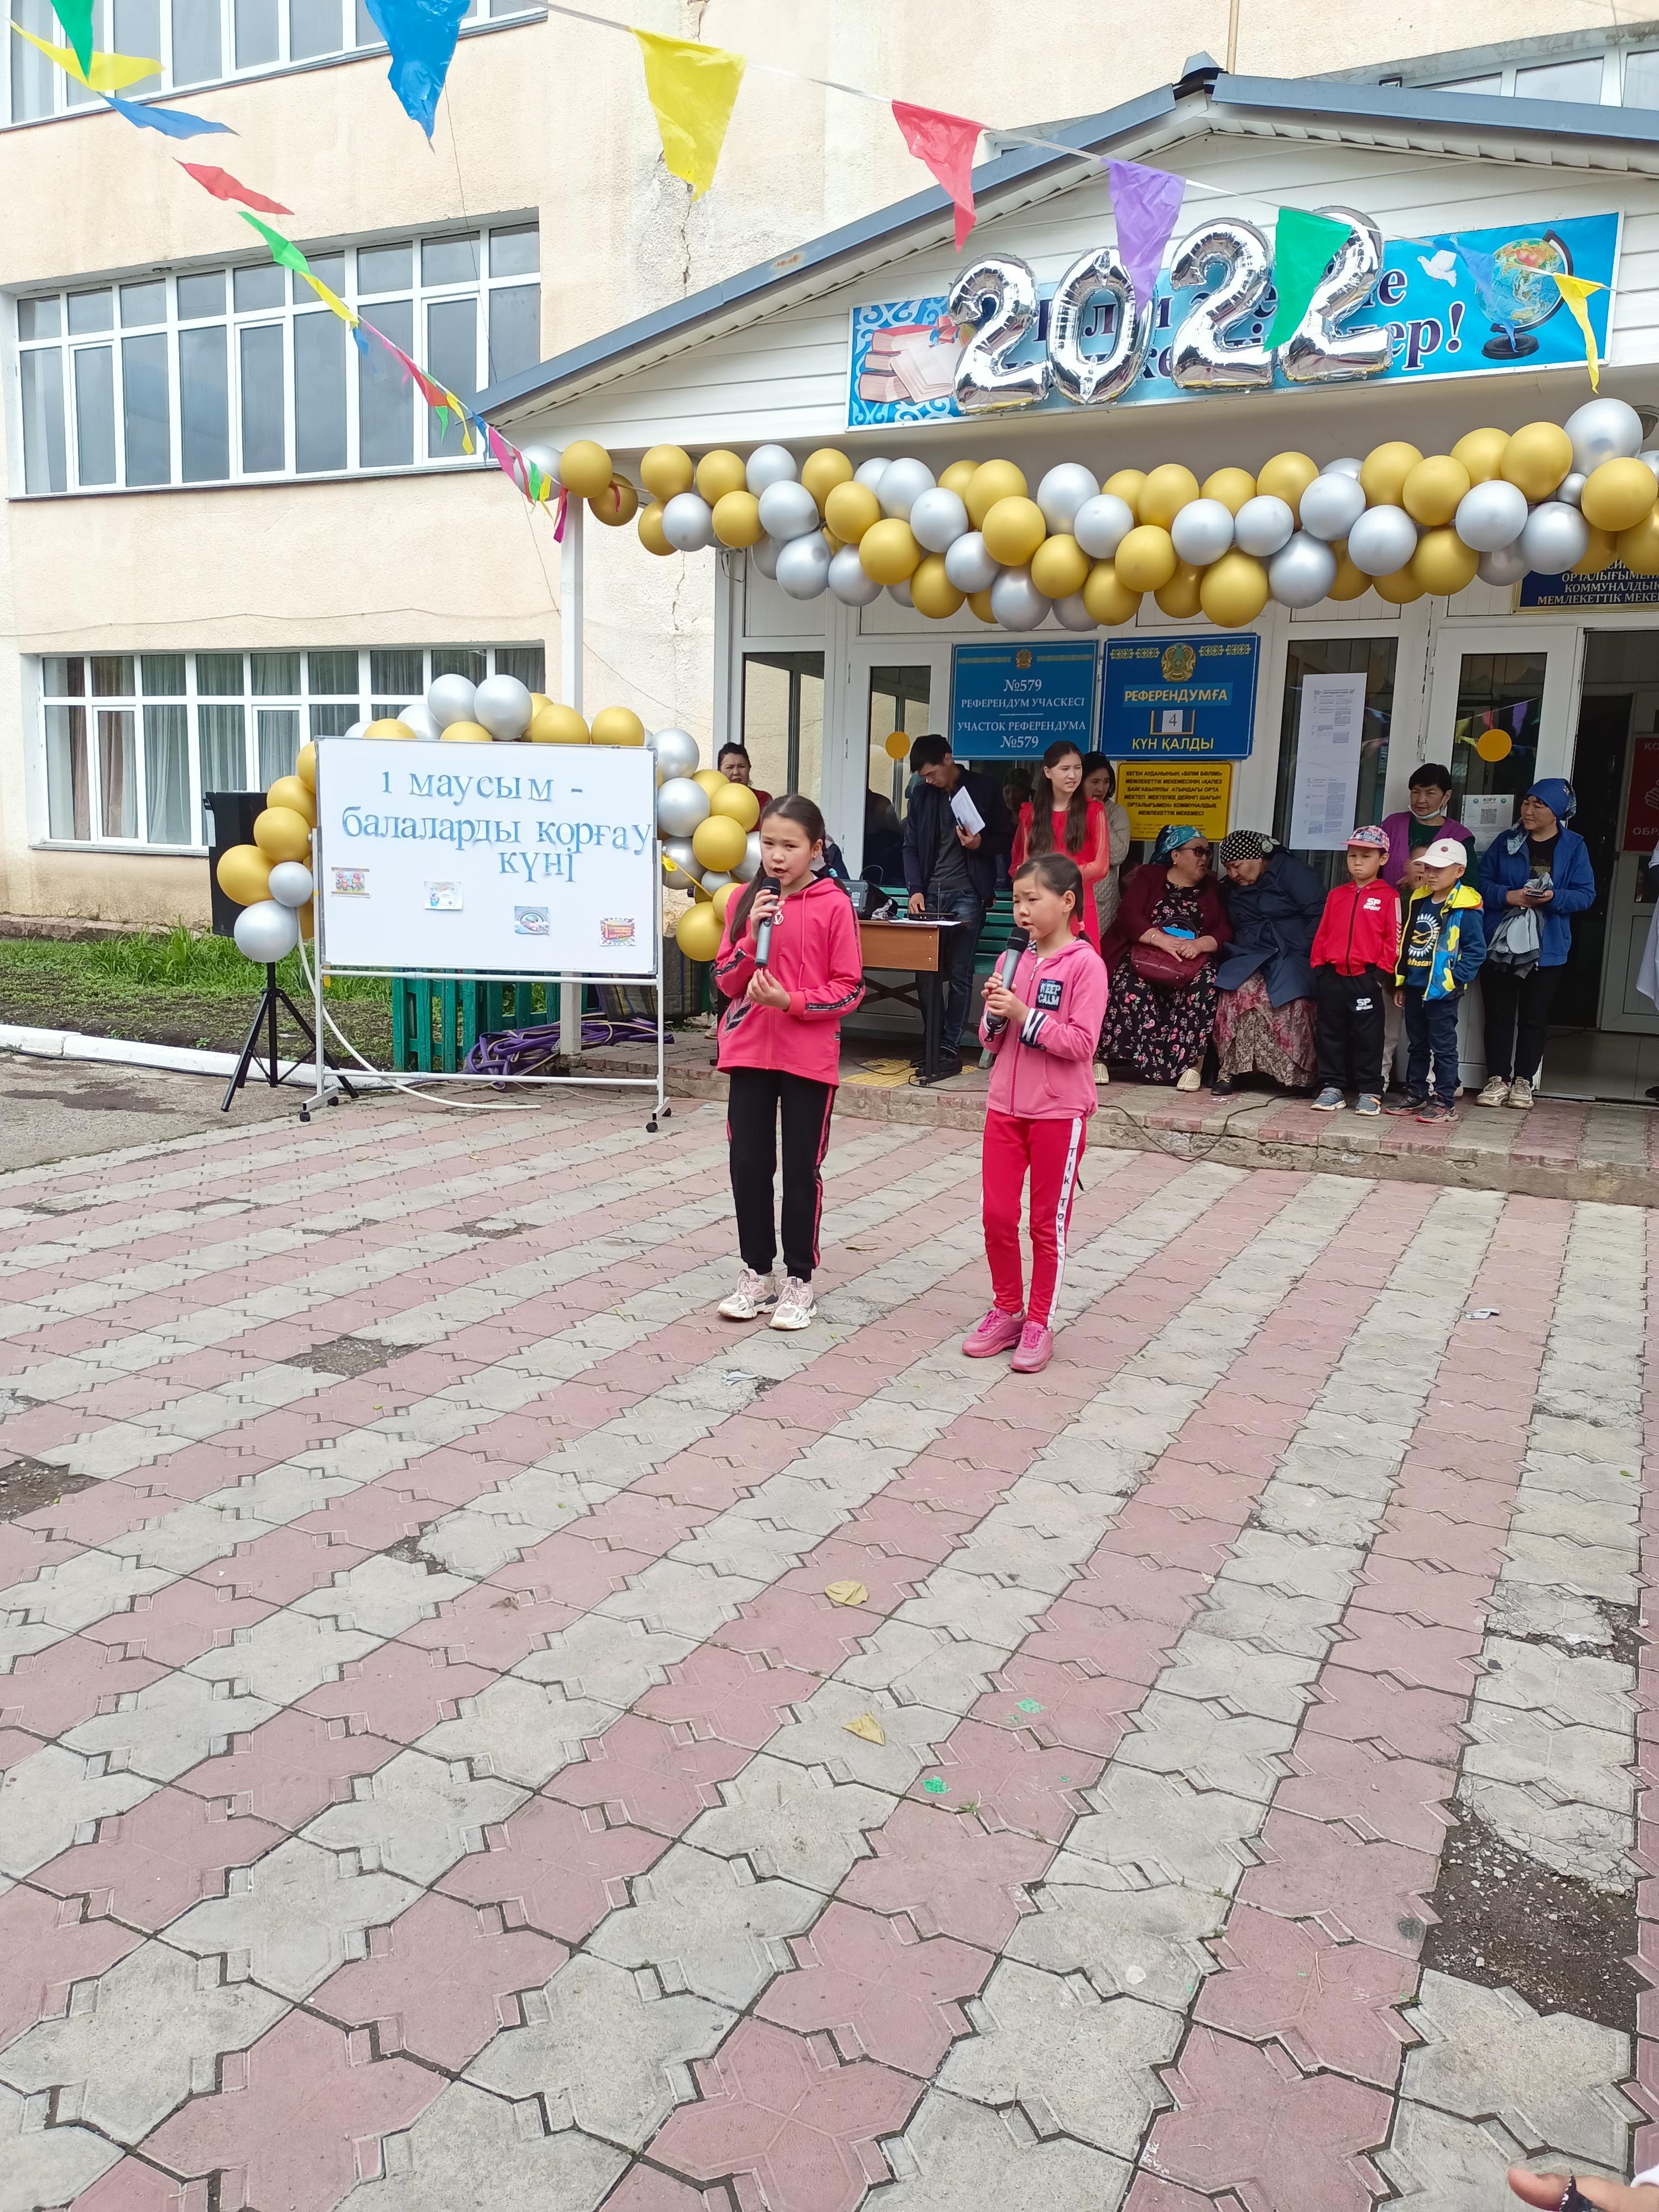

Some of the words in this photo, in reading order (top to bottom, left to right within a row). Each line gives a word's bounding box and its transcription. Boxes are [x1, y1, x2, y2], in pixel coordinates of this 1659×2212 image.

[949, 205, 1394, 414] 2022
[1537, 593, 1621, 605] МЕМЛЕКЕТТІК
[1625, 592, 1659, 602] МЕКЕ
[1003, 679, 1042, 692] №579
[1125, 689, 1228, 703] РЕФЕРЕНДУМҒА
[961, 698, 1029, 709] РЕФЕРЕНДУМ
[1032, 697, 1085, 708] УЧАСКЕСІ
[958, 722, 1005, 732] УЧАСТОК
[1008, 721, 1086, 732] РЕФЕРЕНДУМА
[1168, 713, 1177, 727] 4
[1000, 735, 1039, 748] №579
[1132, 737, 1157, 750] КҮН
[1162, 737, 1214, 752] ҚАЛДЫ
[409, 773, 554, 805] маусым
[342, 806, 521, 851] балаларды
[1632, 827, 1659, 836] ОБР
[498, 848, 576, 883] күні
[1366, 898, 1381, 906] SP
[1040, 983, 1061, 995] KEEP
[1357, 998, 1371, 1006] SP
